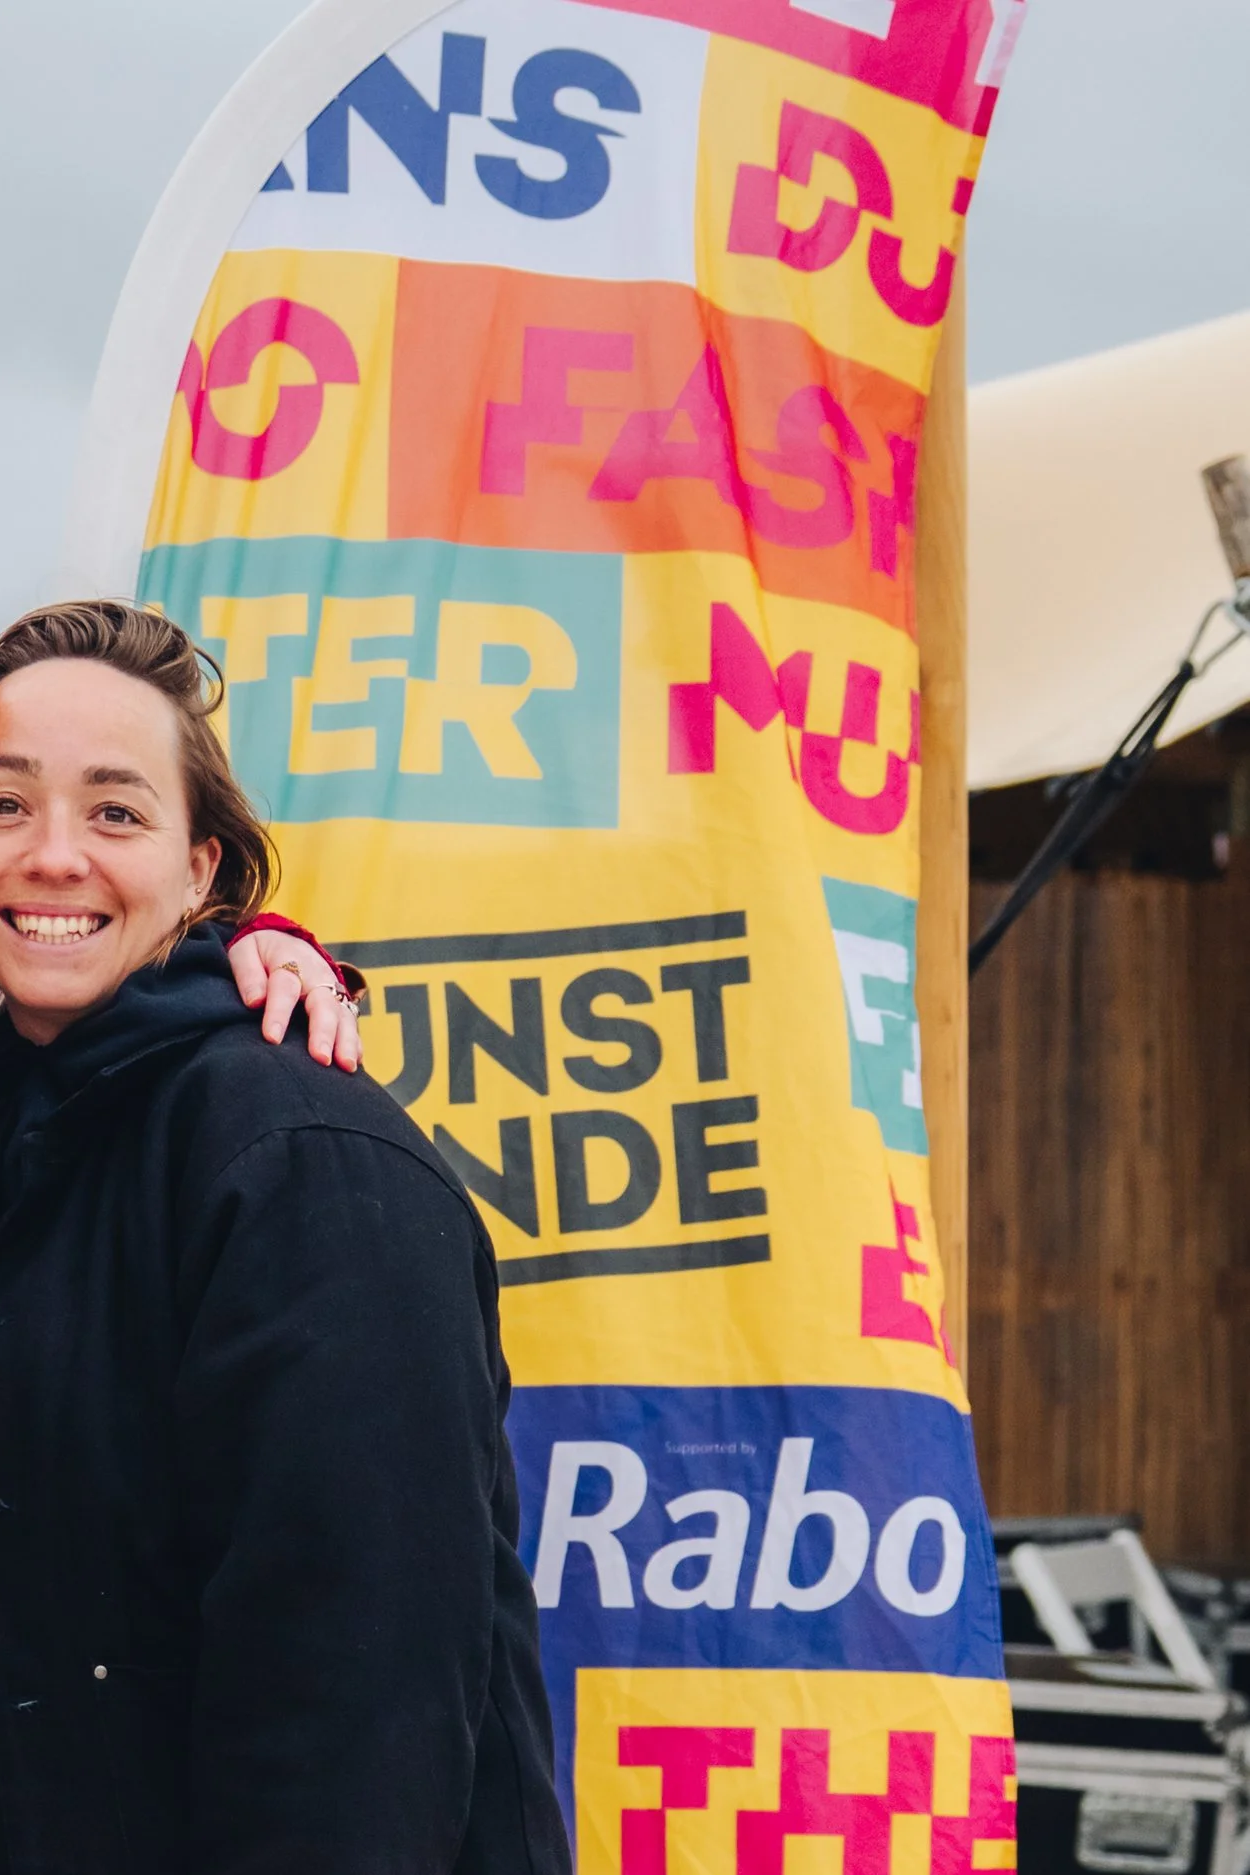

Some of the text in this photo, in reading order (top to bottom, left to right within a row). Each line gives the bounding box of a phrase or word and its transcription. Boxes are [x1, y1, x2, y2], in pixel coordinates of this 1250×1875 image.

[258, 30, 642, 221] NS
[142, 593, 578, 781] TER
[357, 955, 751, 1110] UNST
[432, 1094, 768, 1238] NDE
[532, 1437, 966, 1616] Rabo
[664, 1440, 758, 1457] Supported by
